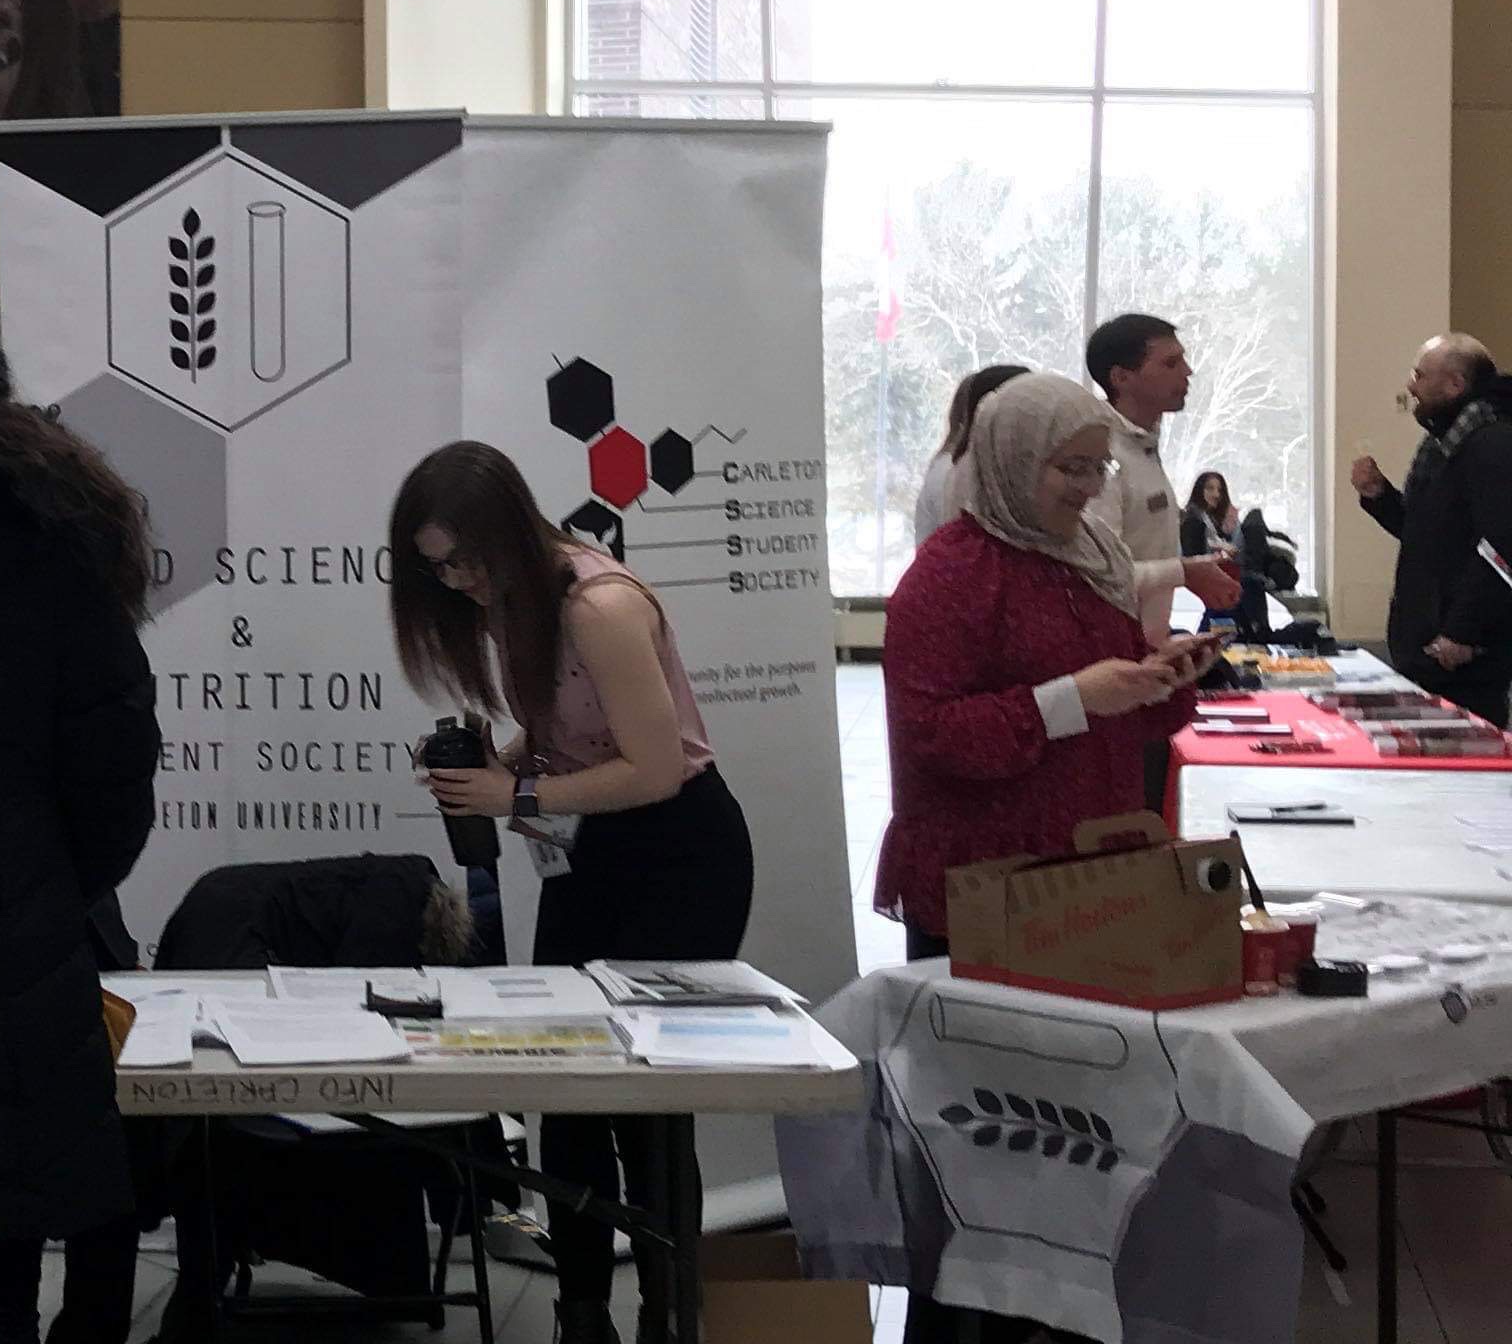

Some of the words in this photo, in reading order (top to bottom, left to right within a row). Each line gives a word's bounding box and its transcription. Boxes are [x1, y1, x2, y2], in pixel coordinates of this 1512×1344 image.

[724, 498, 816, 523] SCIENCE
[726, 532, 820, 558] STUDENT
[215, 545, 395, 586] SCIENC
[728, 568, 821, 594] SOCIETY
[231, 615, 253, 648] &
[152, 671, 382, 712] TRITION
[152, 800, 217, 831] ETON
[237, 800, 383, 832] UNIVERSITY
